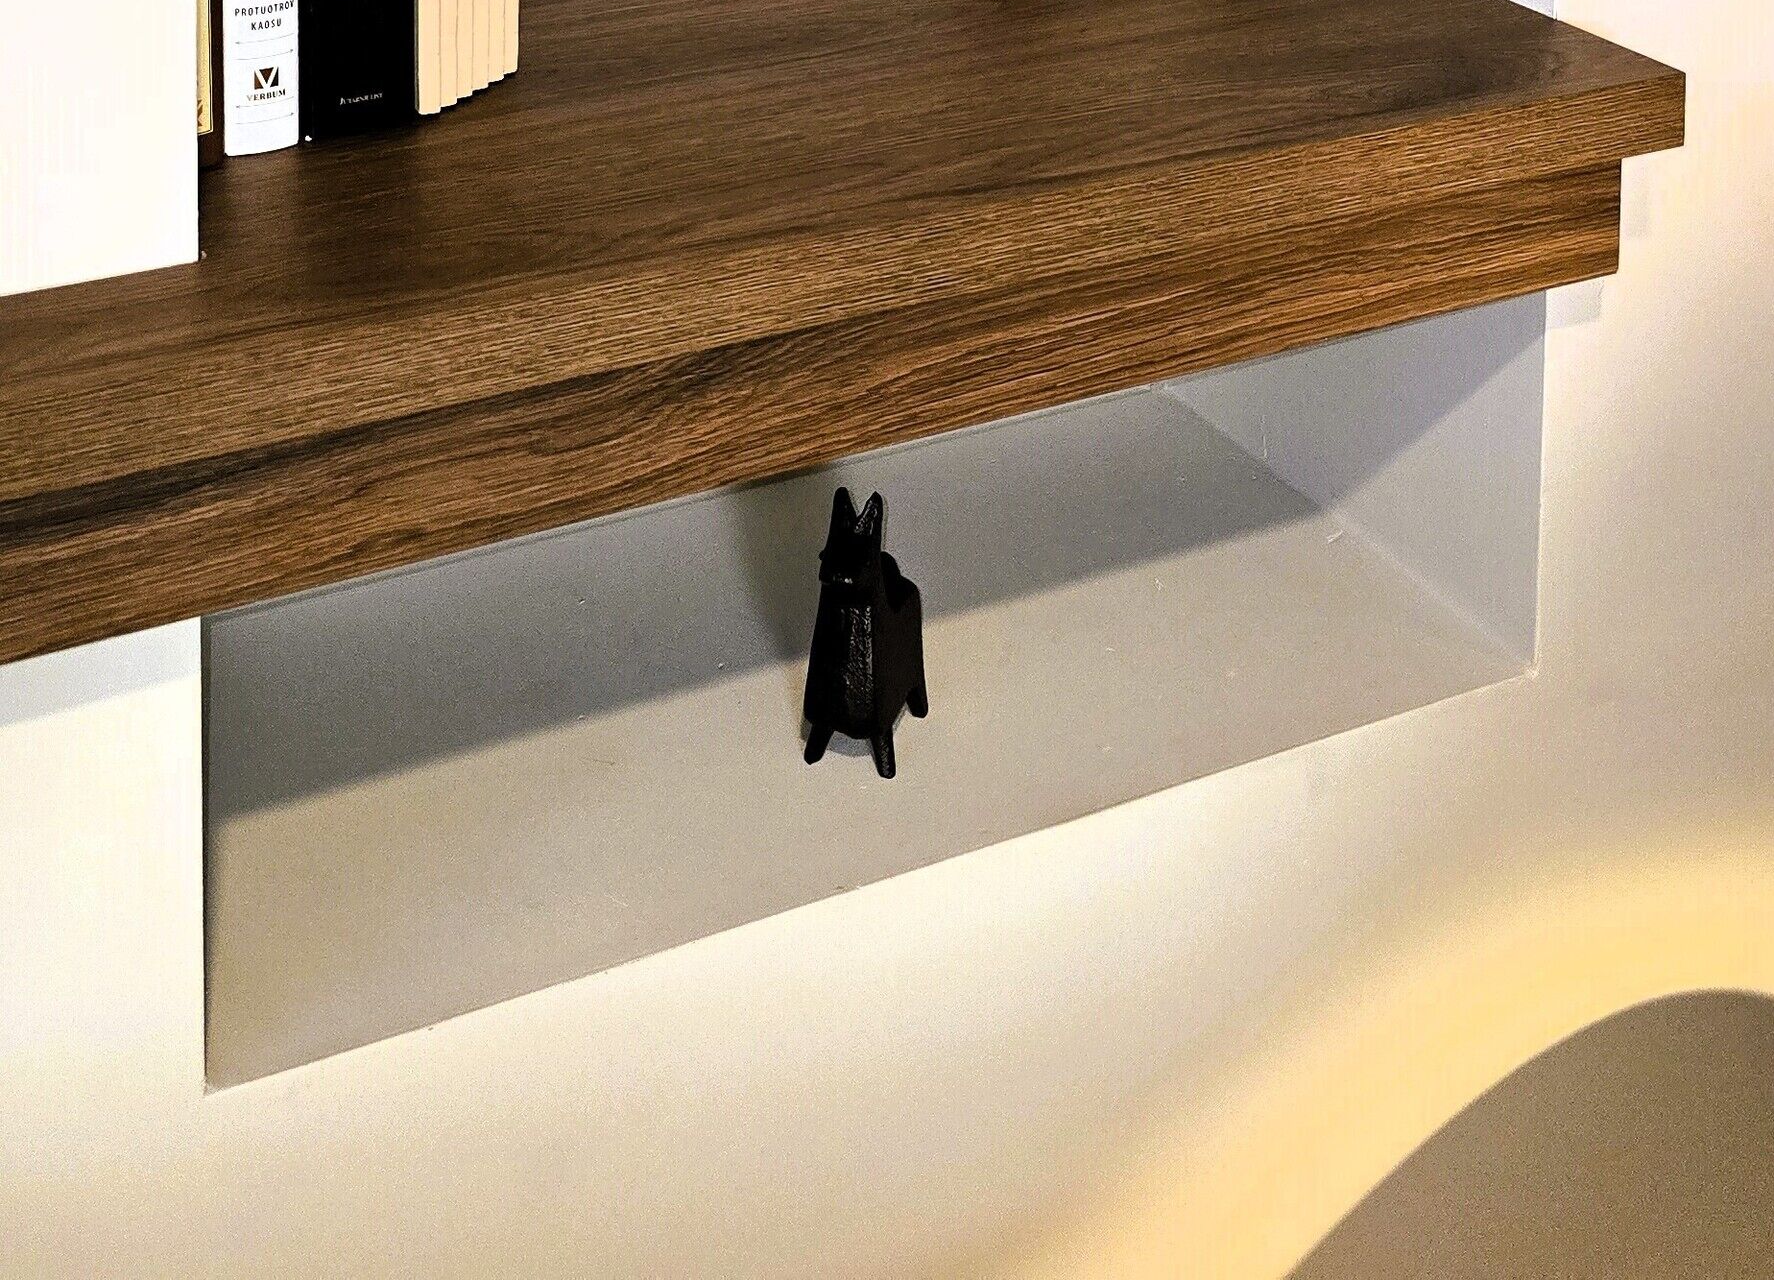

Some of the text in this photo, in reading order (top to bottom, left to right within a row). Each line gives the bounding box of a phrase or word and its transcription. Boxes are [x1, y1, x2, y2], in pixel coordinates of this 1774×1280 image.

[234, 0, 295, 17] PROTUOTROV
[250, 18, 282, 31] KAOSU
[246, 88, 286, 102] VERBUM
